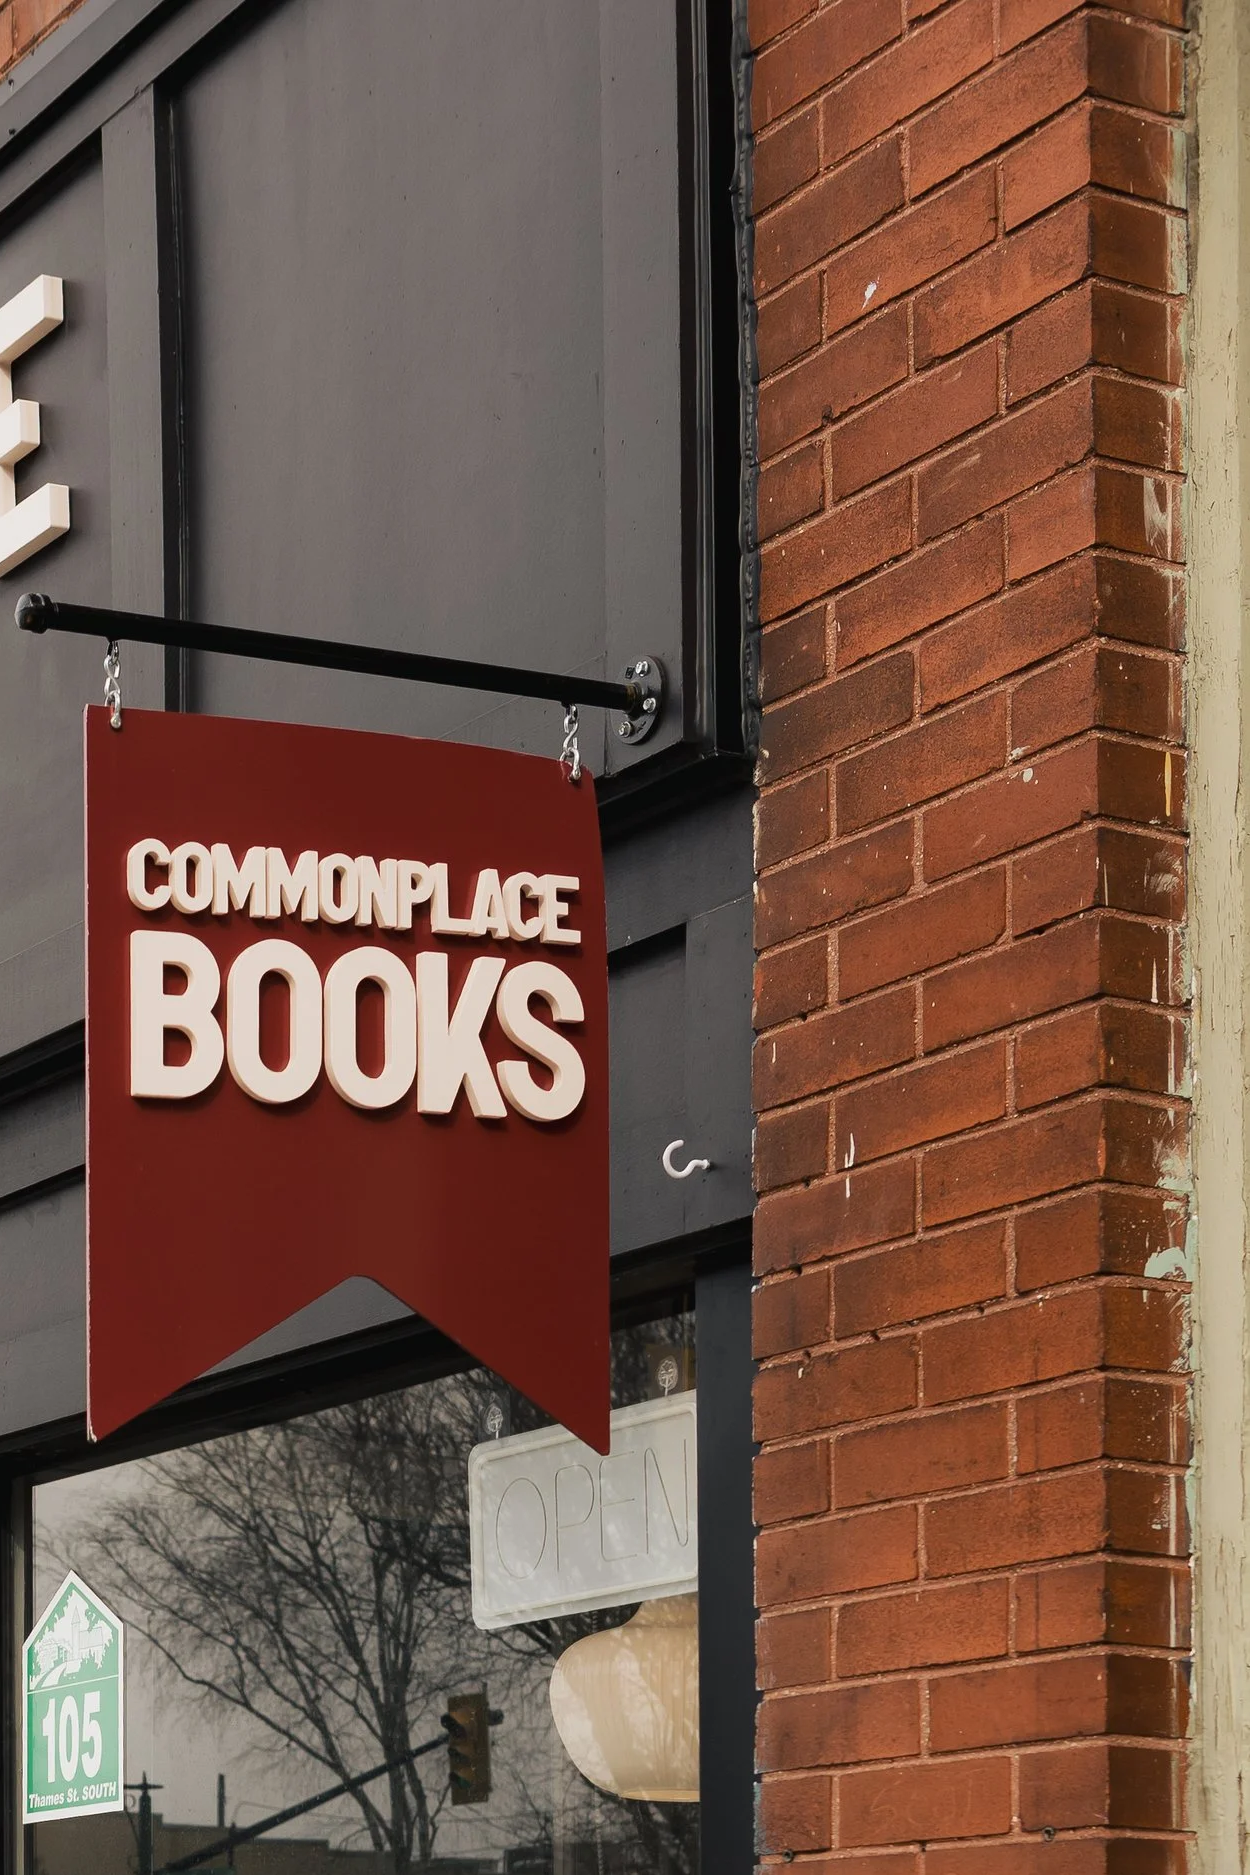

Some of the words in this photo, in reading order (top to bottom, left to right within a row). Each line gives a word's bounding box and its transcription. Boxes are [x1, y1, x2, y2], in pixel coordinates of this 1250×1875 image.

[127, 838, 581, 945] COMMONPLACE
[129, 930, 586, 1122] BOOKS
[496, 1439, 689, 1579] OPEN
[42, 1691, 103, 1784] 105
[28, 1791, 65, 1809] Thames
[66, 1789, 80, 1803] St.
[82, 1781, 117, 1801] SOUTH
